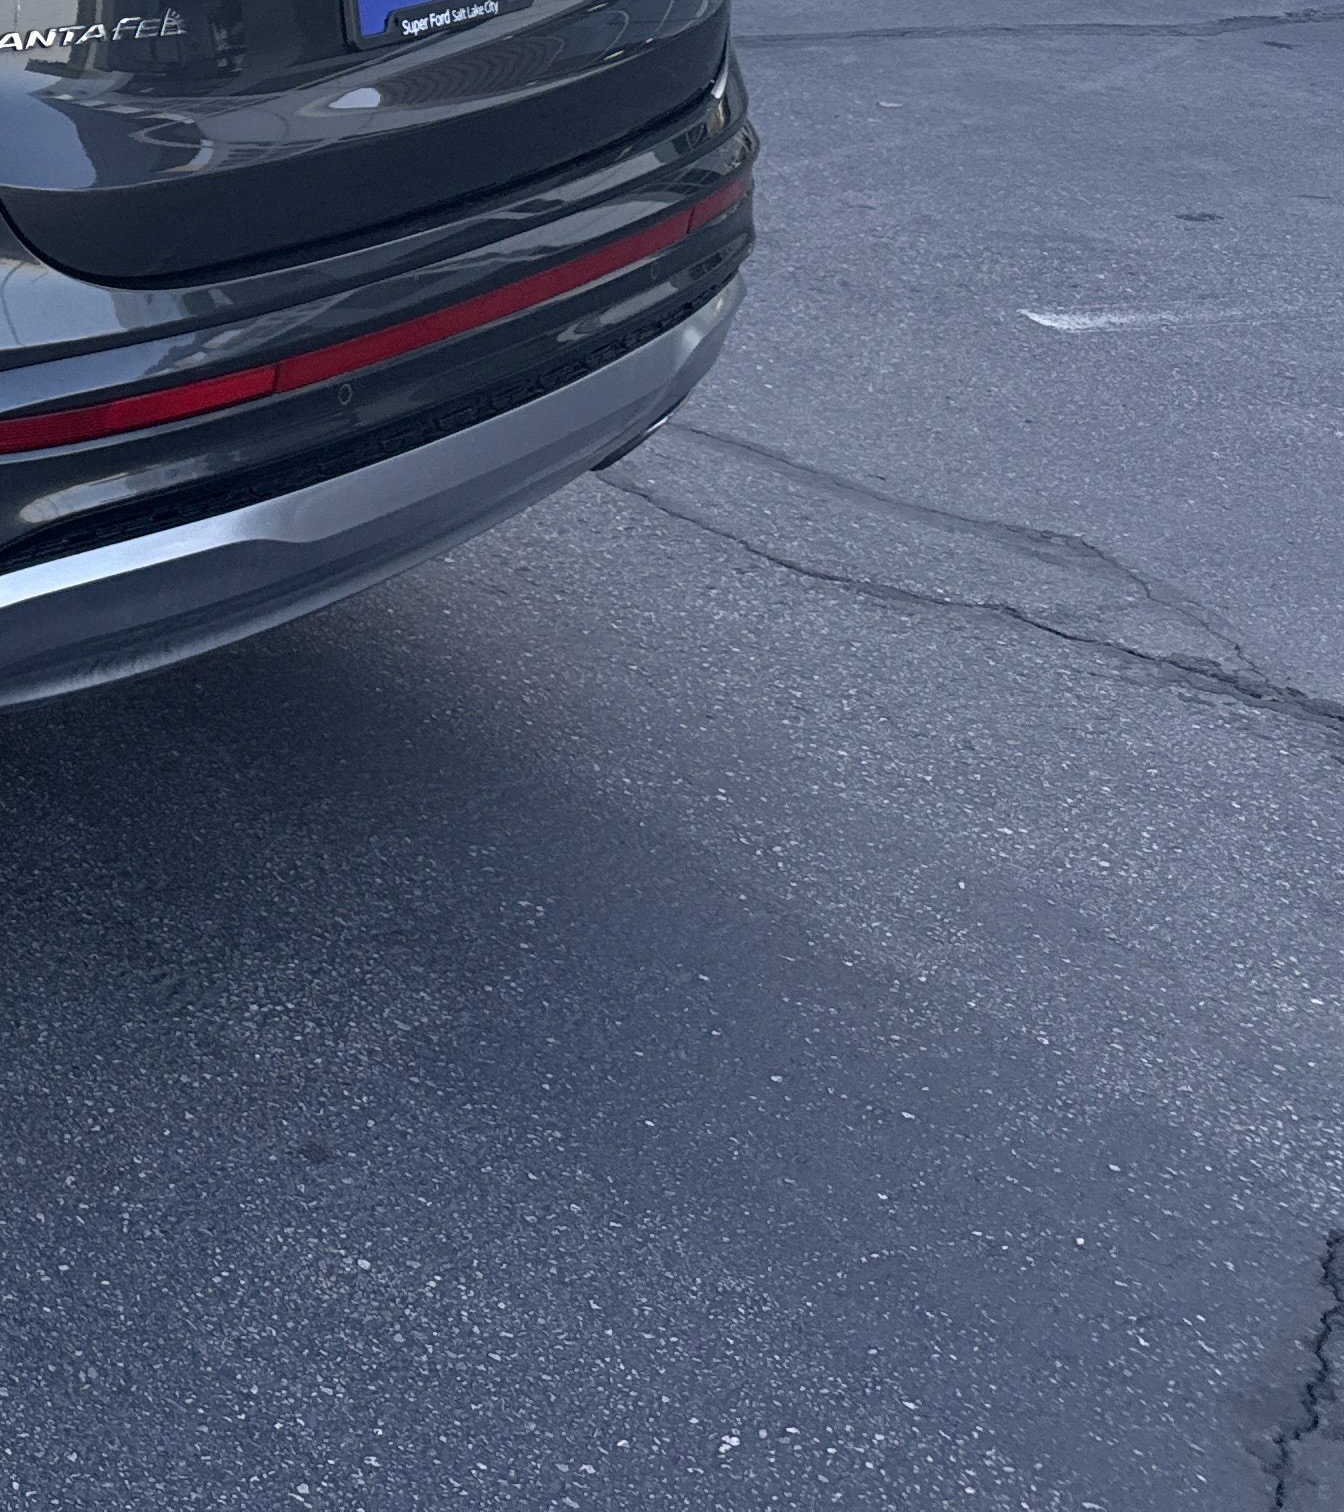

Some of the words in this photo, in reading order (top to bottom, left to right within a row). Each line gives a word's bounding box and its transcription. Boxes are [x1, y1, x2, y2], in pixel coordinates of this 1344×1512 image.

[402, 17, 429, 36] Super
[429, 8, 451, 28] Ford
[452, 7, 467, 22] Salt
[467, 4, 485, 18] Lake
